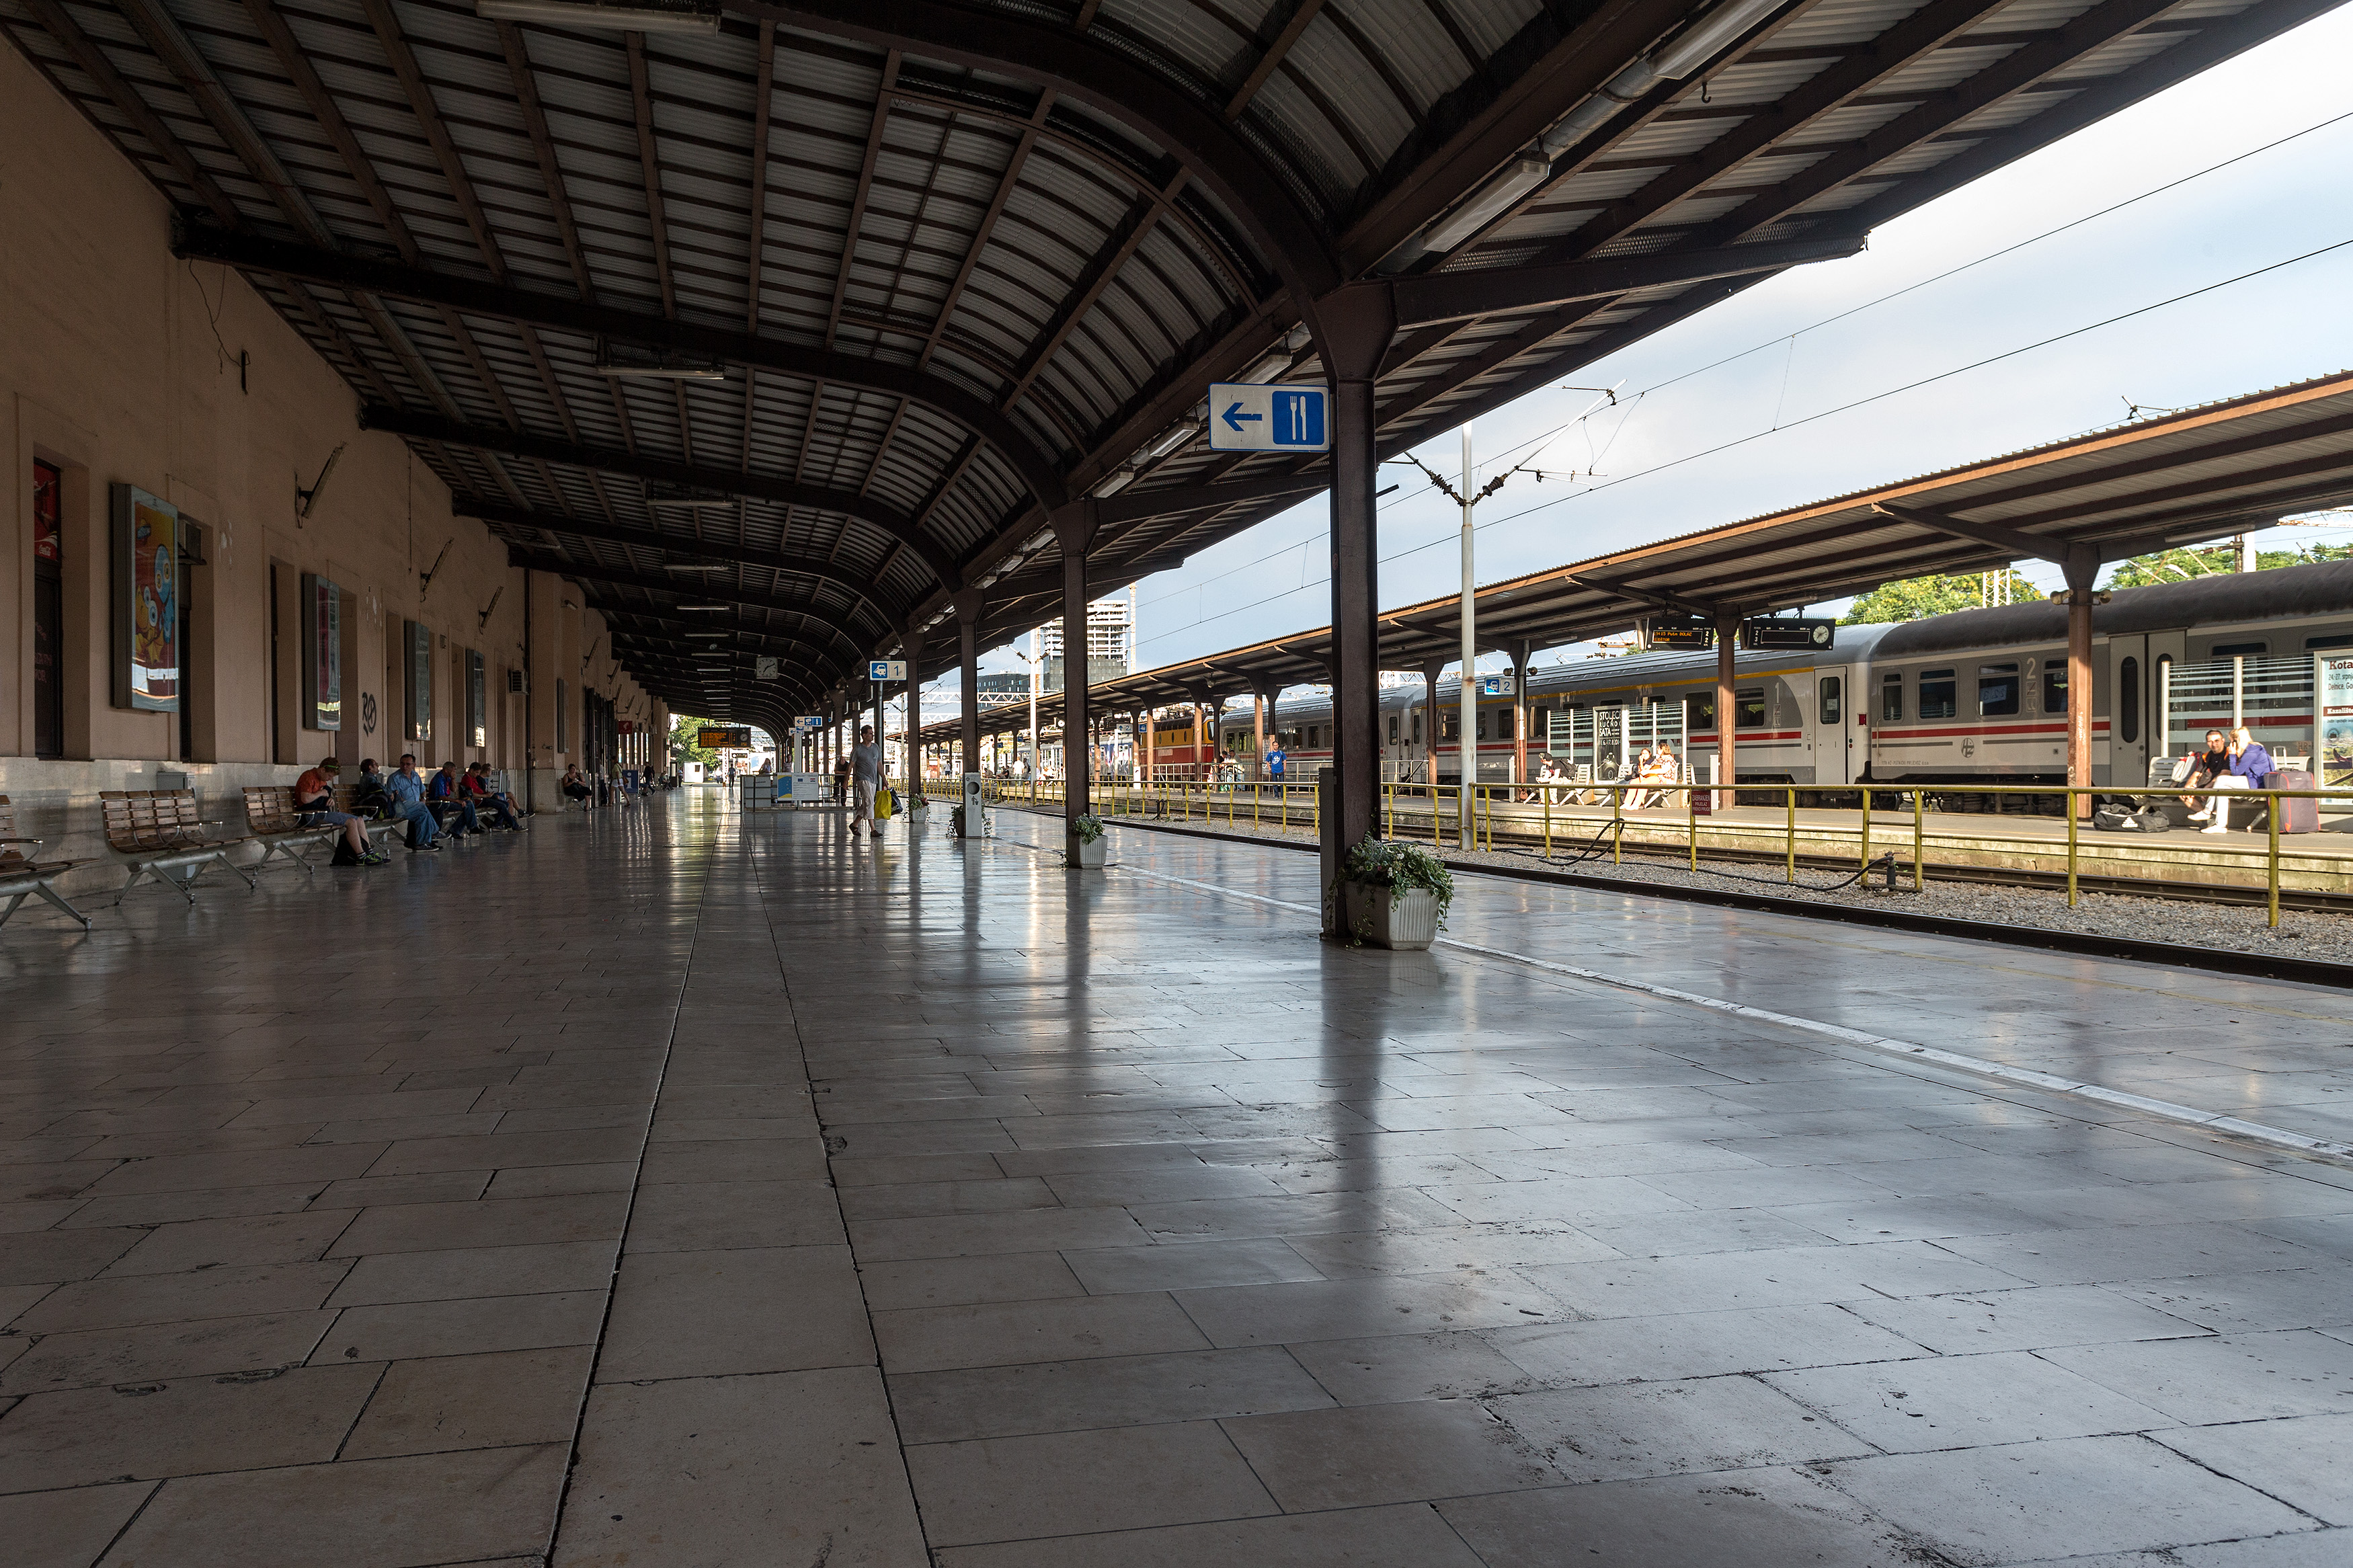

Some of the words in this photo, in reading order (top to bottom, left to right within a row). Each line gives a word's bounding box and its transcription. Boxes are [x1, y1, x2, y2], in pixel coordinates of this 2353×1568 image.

[893, 665, 899, 676] 1
[2026, 657, 2036, 679] 2
[1503, 681, 1511, 692] 2
[1775, 682, 1780, 704] 1
[1599, 728, 1611, 737] SATA
